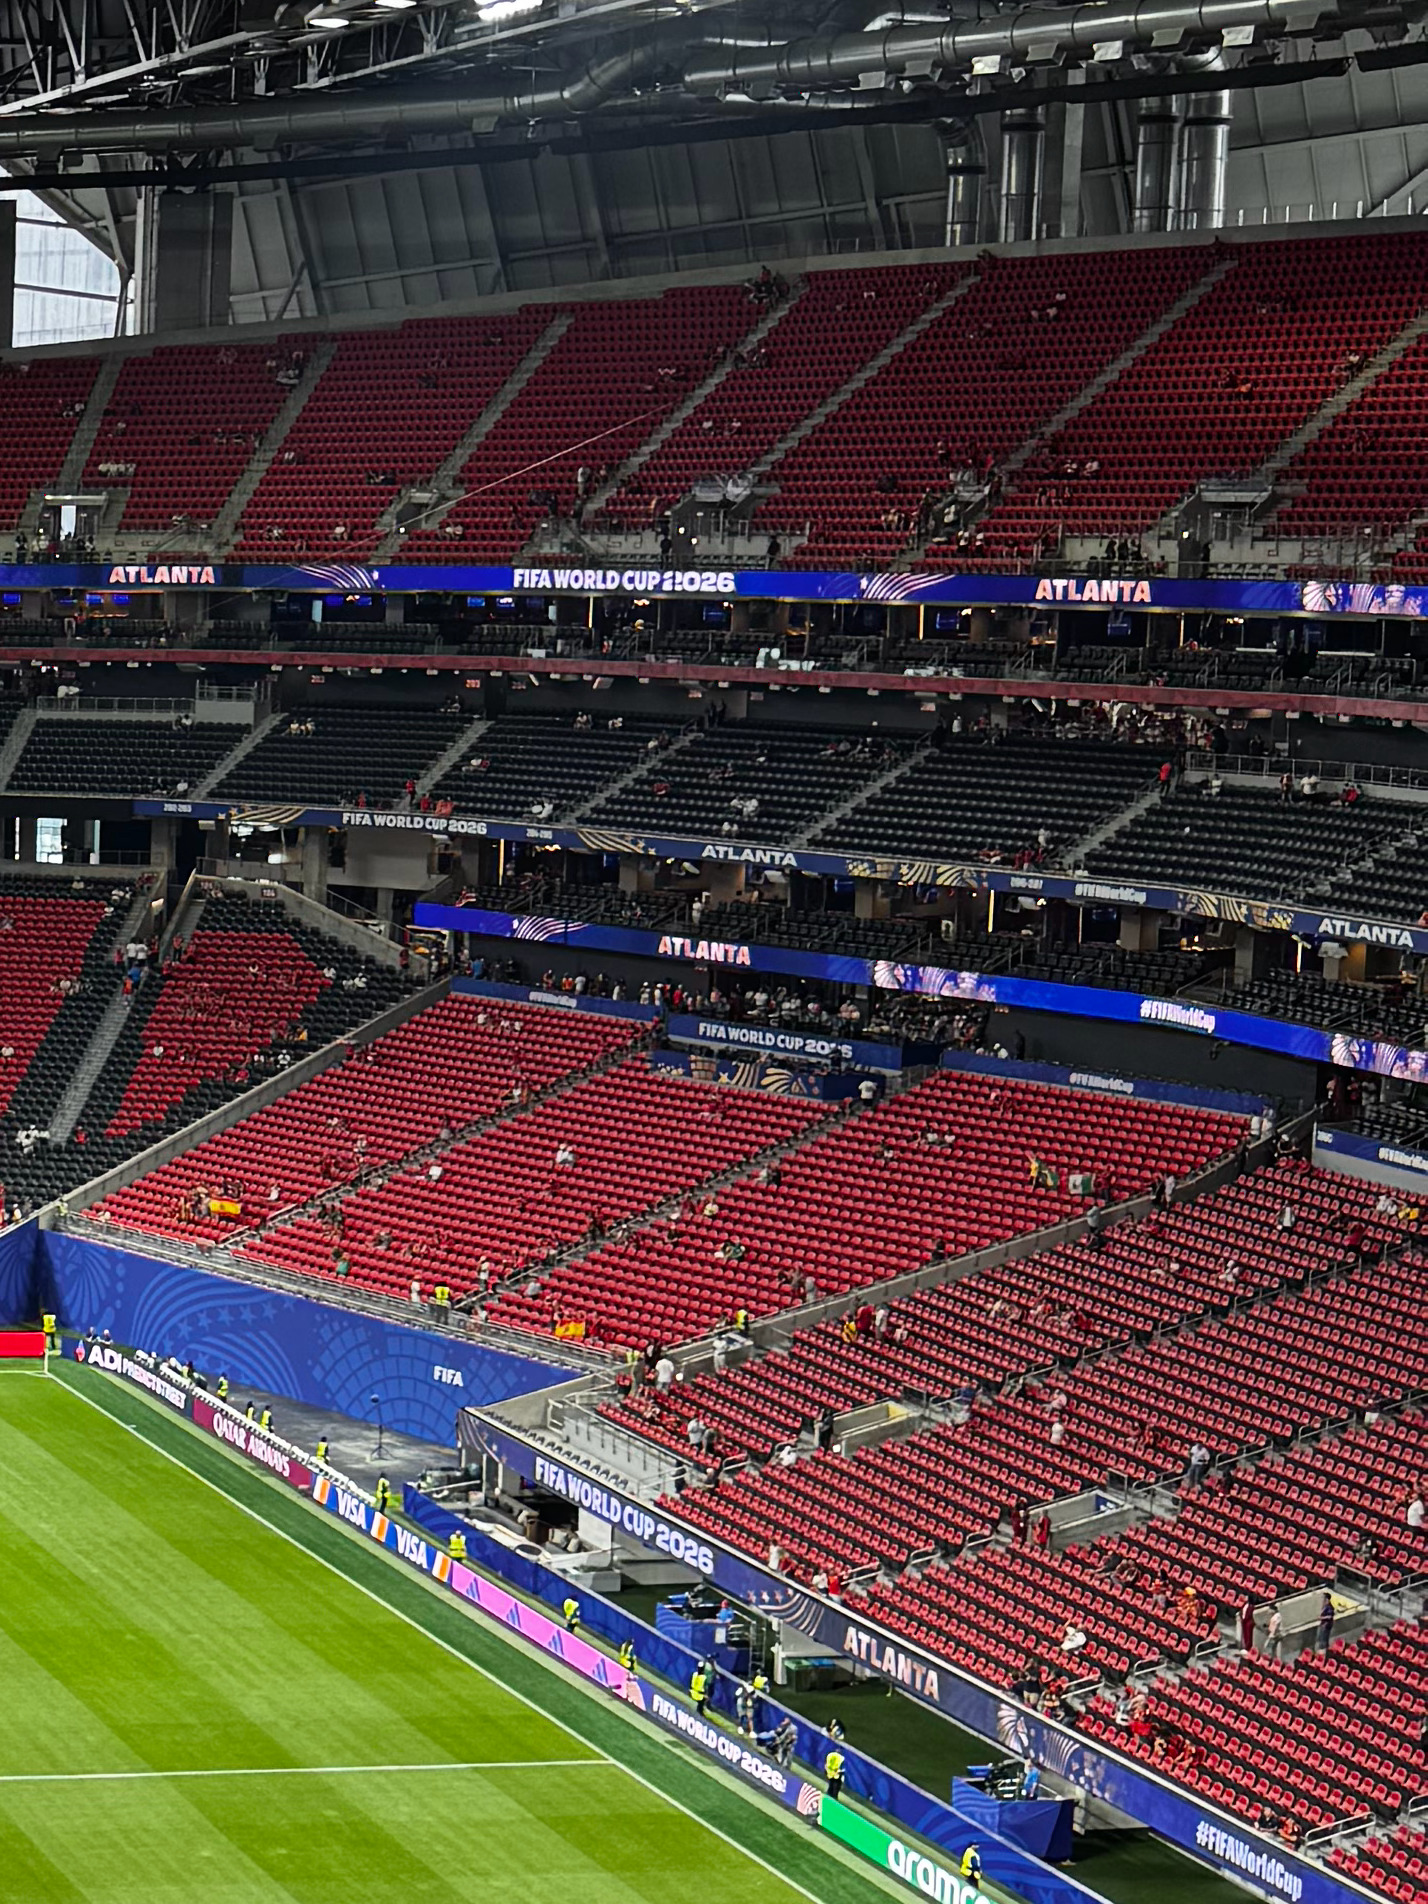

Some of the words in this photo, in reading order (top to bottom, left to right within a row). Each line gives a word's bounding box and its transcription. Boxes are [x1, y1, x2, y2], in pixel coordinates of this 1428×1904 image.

[109, 566, 216, 584] ATLANTA
[513, 568, 552, 588] FIFA
[553, 569, 621, 590] WORLD
[622, 570, 661, 591] CUP
[1035, 578, 1152, 604] ATLANTA
[342, 812, 372, 827] FIFA
[374, 814, 425, 829] WORLD
[425, 817, 448, 832] CUP
[448, 820, 488, 835] 2026
[701, 844, 798, 867] ATLANTA
[1318, 917, 1414, 948] ATLANTA
[657, 935, 751, 966] ATLANTA
[698, 1022, 727, 1038] FIFA
[727, 1026, 776, 1047] WORLD
[776, 1033, 804, 1050] CUP
[433, 1365, 464, 1387] FIFA
[212, 1411, 246, 1450] QATAR
[247, 1434, 291, 1478] AIRWAYS
[335, 1486, 367, 1530] VISA
[534, 1456, 567, 1494] FIFA
[567, 1474, 622, 1524] WORLD
[622, 1504, 655, 1541] CUP
[655, 1524, 715, 1575] 2026
[394, 1523, 428, 1569] VISA
[844, 1625, 941, 1703] ATLANTA
[651, 1693, 678, 1726] FIFA
[677, 1708, 719, 1750] WORLD
[717, 1735, 742, 1764] CUP
[740, 1750, 785, 1793] 2026
[1194, 1820, 1304, 1902] #FIFAWorldCup
